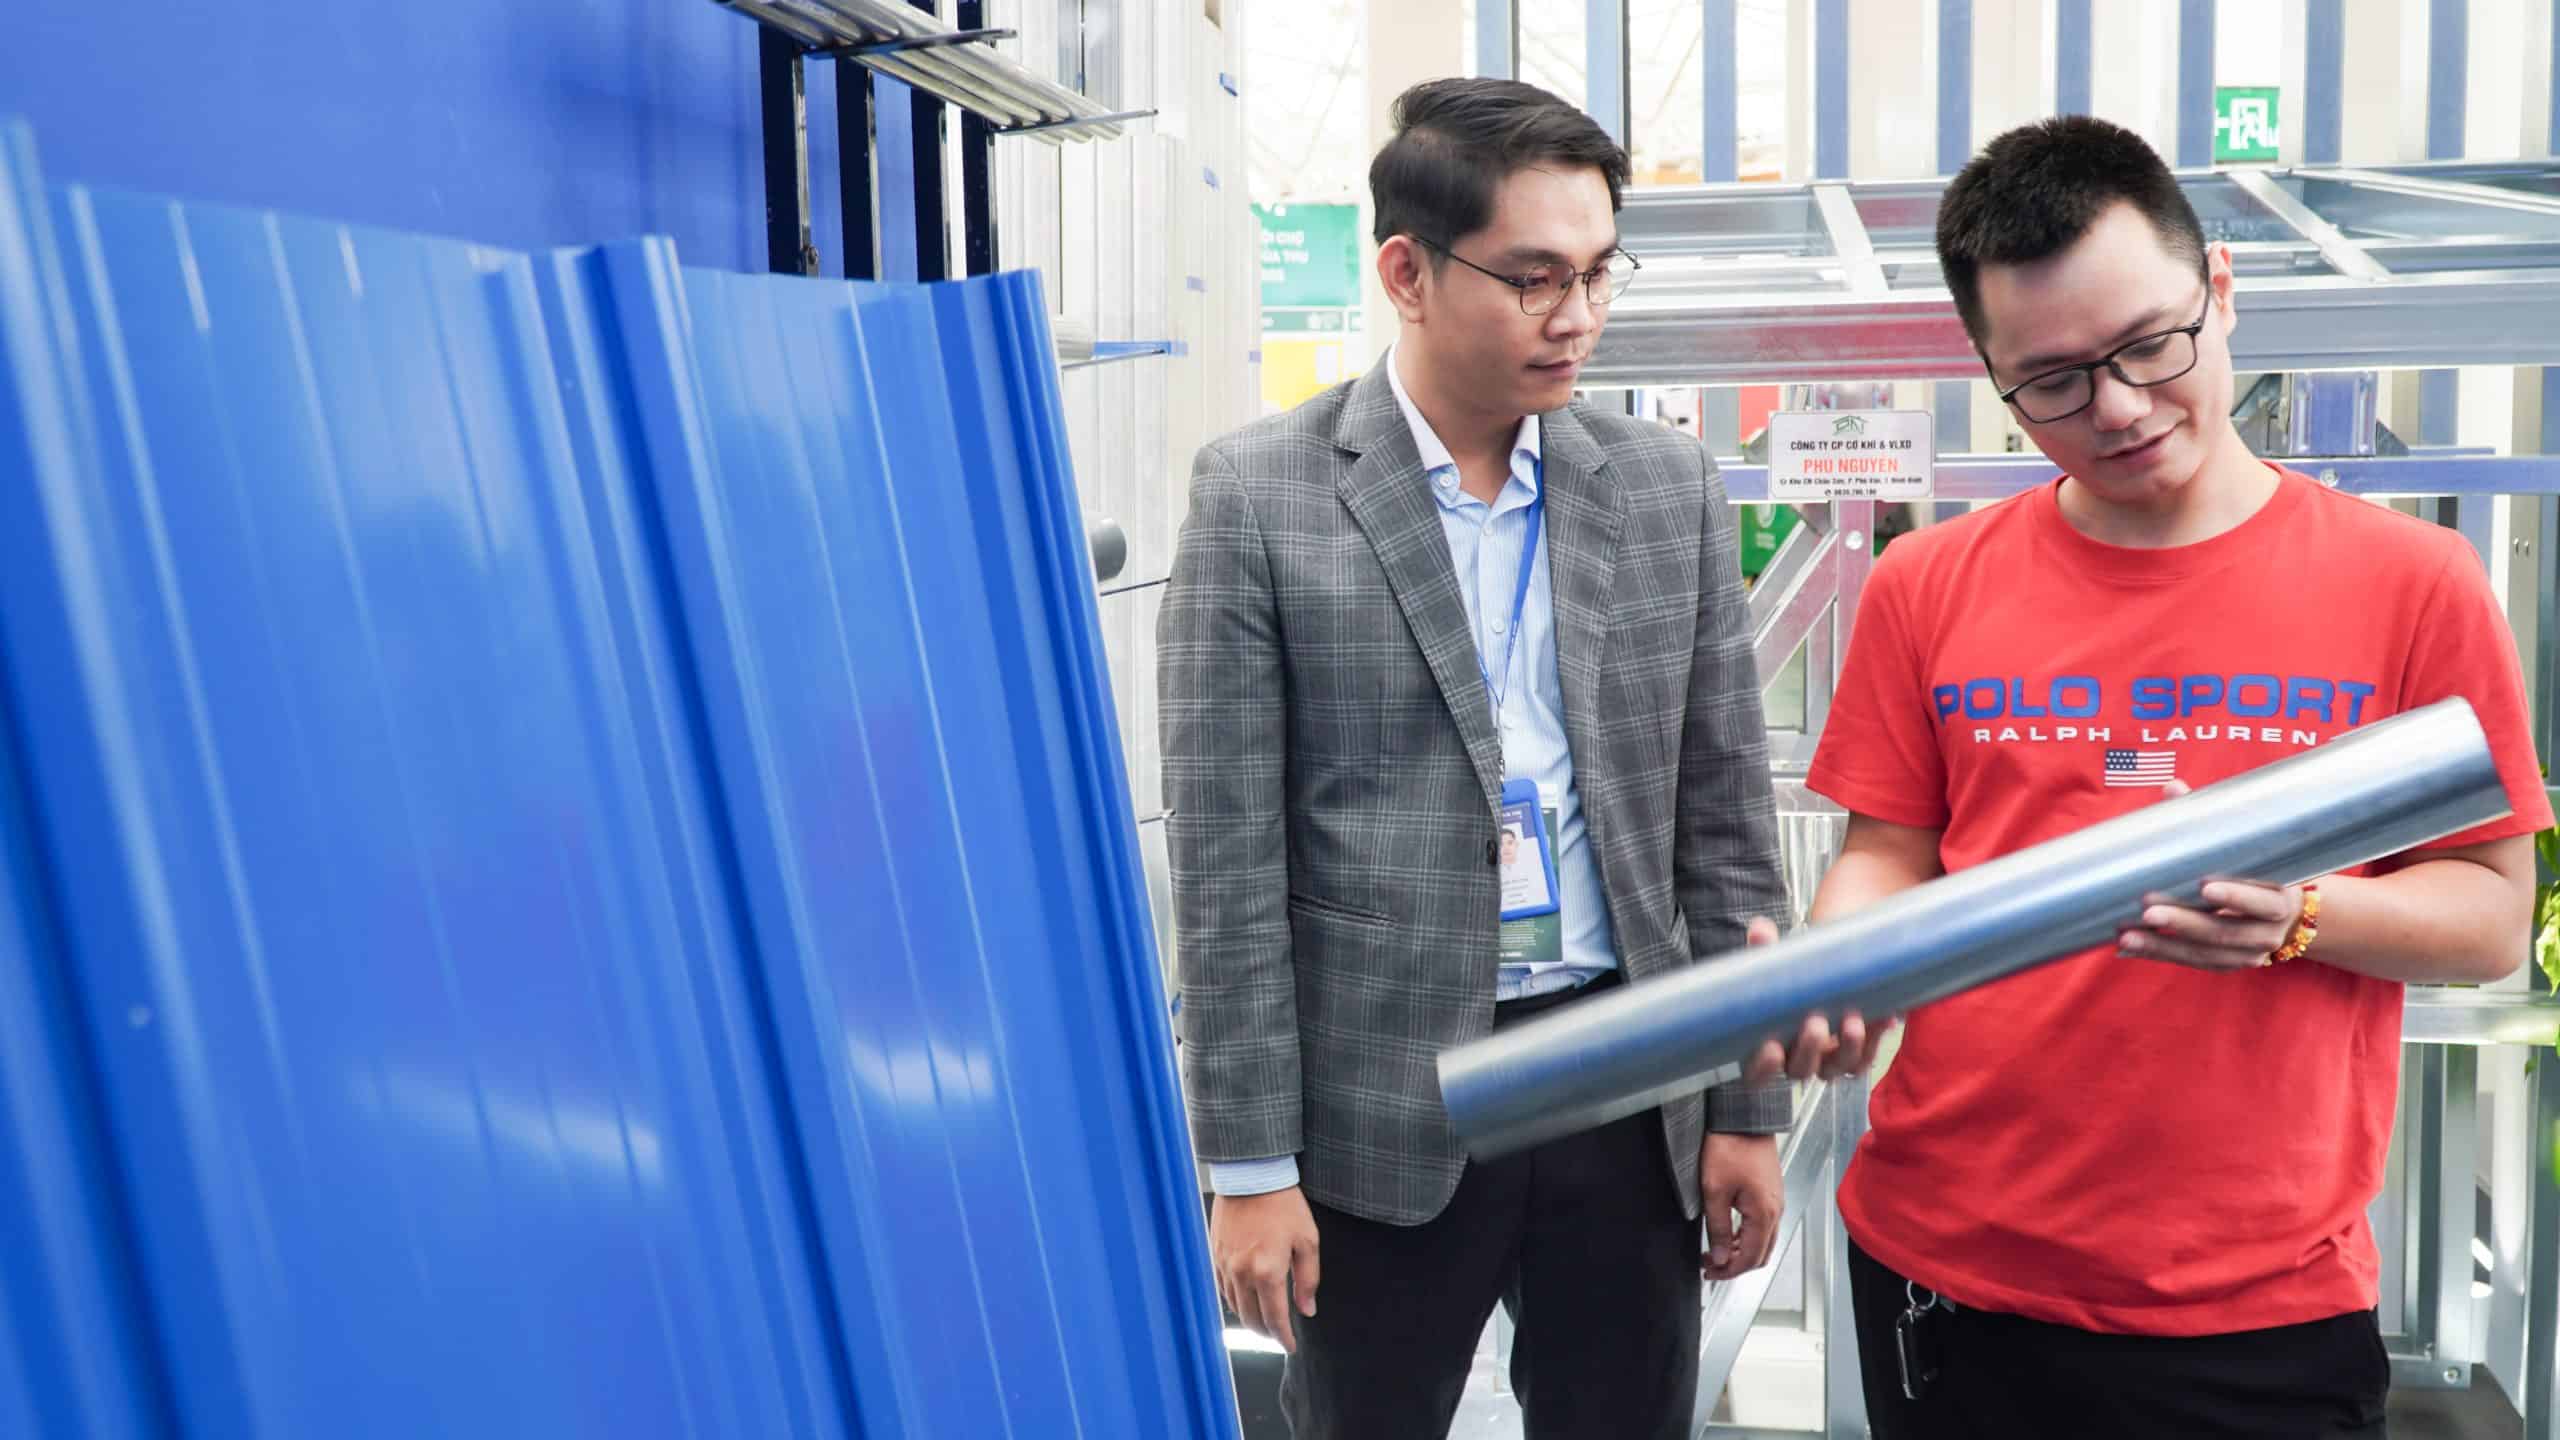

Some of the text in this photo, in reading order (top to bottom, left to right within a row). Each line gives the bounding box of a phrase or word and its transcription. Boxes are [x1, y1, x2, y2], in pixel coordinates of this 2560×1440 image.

[1818, 440, 1828, 450] TY
[1831, 440, 1843, 450] CP
[1879, 440, 1886, 449] &
[1889, 439, 1912, 449] VLXD
[1932, 673, 2377, 727] POLO SPORT
[1973, 725, 2318, 746] RALPH LAUREN
